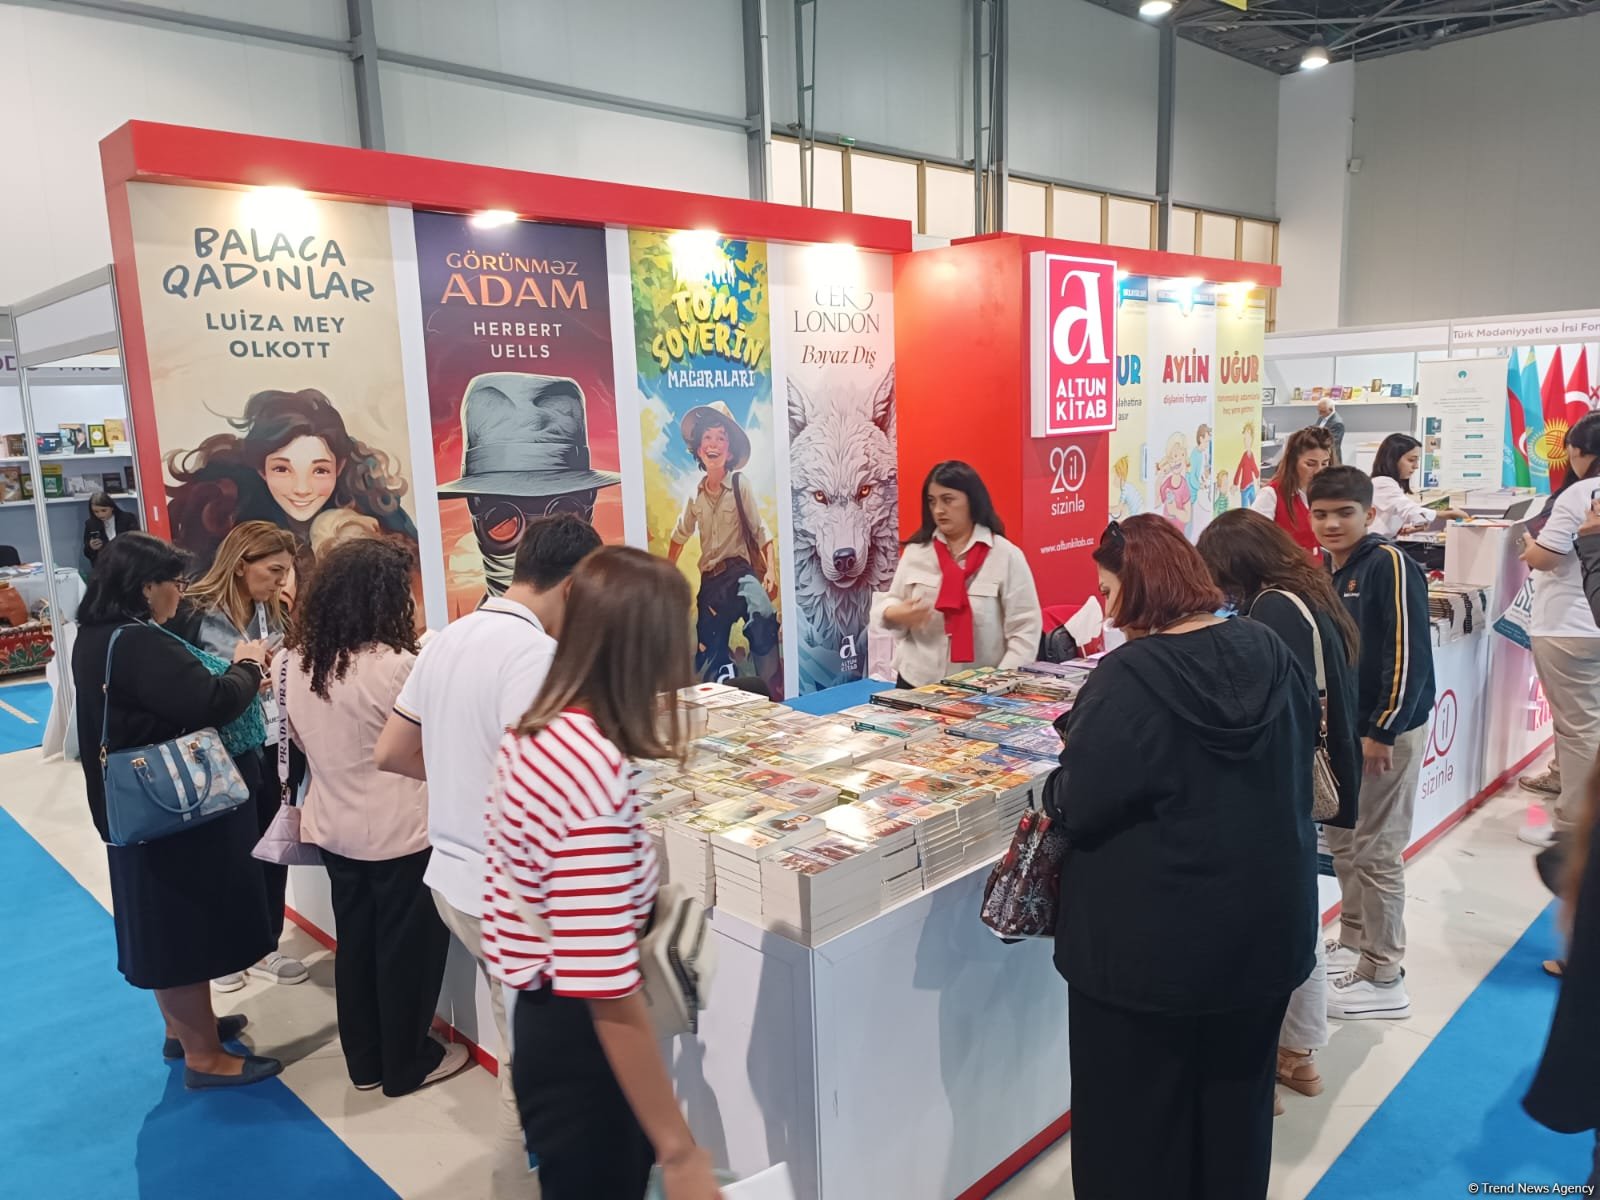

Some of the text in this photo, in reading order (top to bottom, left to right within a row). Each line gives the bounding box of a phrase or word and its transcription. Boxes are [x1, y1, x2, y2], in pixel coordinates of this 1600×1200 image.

[194, 227, 346, 267] BALACA
[162, 263, 375, 302] QADINLAR
[440, 273, 588, 310] ADAM
[671, 290, 739, 325] TOM
[206, 309, 345, 333] LUİZA MEY
[473, 321, 563, 337] HERBERT
[793, 310, 880, 334] LONDON
[1453, 330, 1474, 339] Türk
[1545, 326, 1559, 335] və
[1561, 321, 1578, 333] İrsi
[229, 339, 331, 358] OLKOTT
[490, 344, 550, 358] UELLS
[652, 322, 764, 370] SOYERİN
[800, 345, 877, 370] Bəyaz Diş
[1163, 348, 1209, 384] AYLİN
[1220, 350, 1259, 384] UĞUR
[1056, 378, 1106, 398] ALTUN
[1056, 398, 1107, 421] KİTAB
[1050, 444, 1086, 494] 20
[1051, 493, 1085, 516] sizinlə
[280, 659, 288, 706] PRADA
